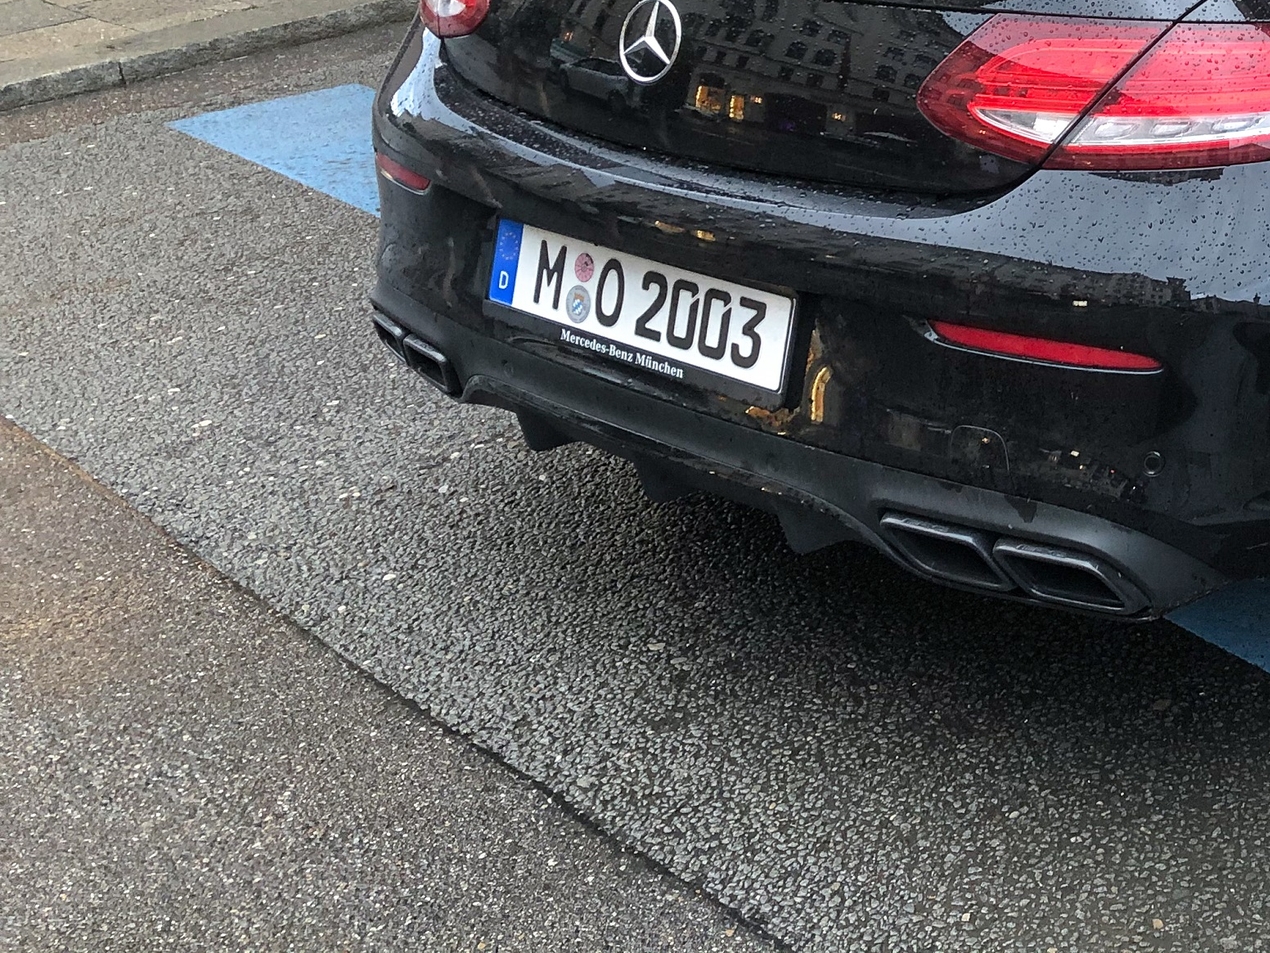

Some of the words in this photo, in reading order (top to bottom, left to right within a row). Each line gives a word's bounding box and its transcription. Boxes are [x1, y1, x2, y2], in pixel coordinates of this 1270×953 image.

[498, 270, 509, 290] D
[533, 239, 568, 311] M
[595, 258, 626, 328] O
[634, 270, 767, 369] 2003
[560, 328, 634, 363] Mercedes-Benz
[634, 352, 684, 379] München
